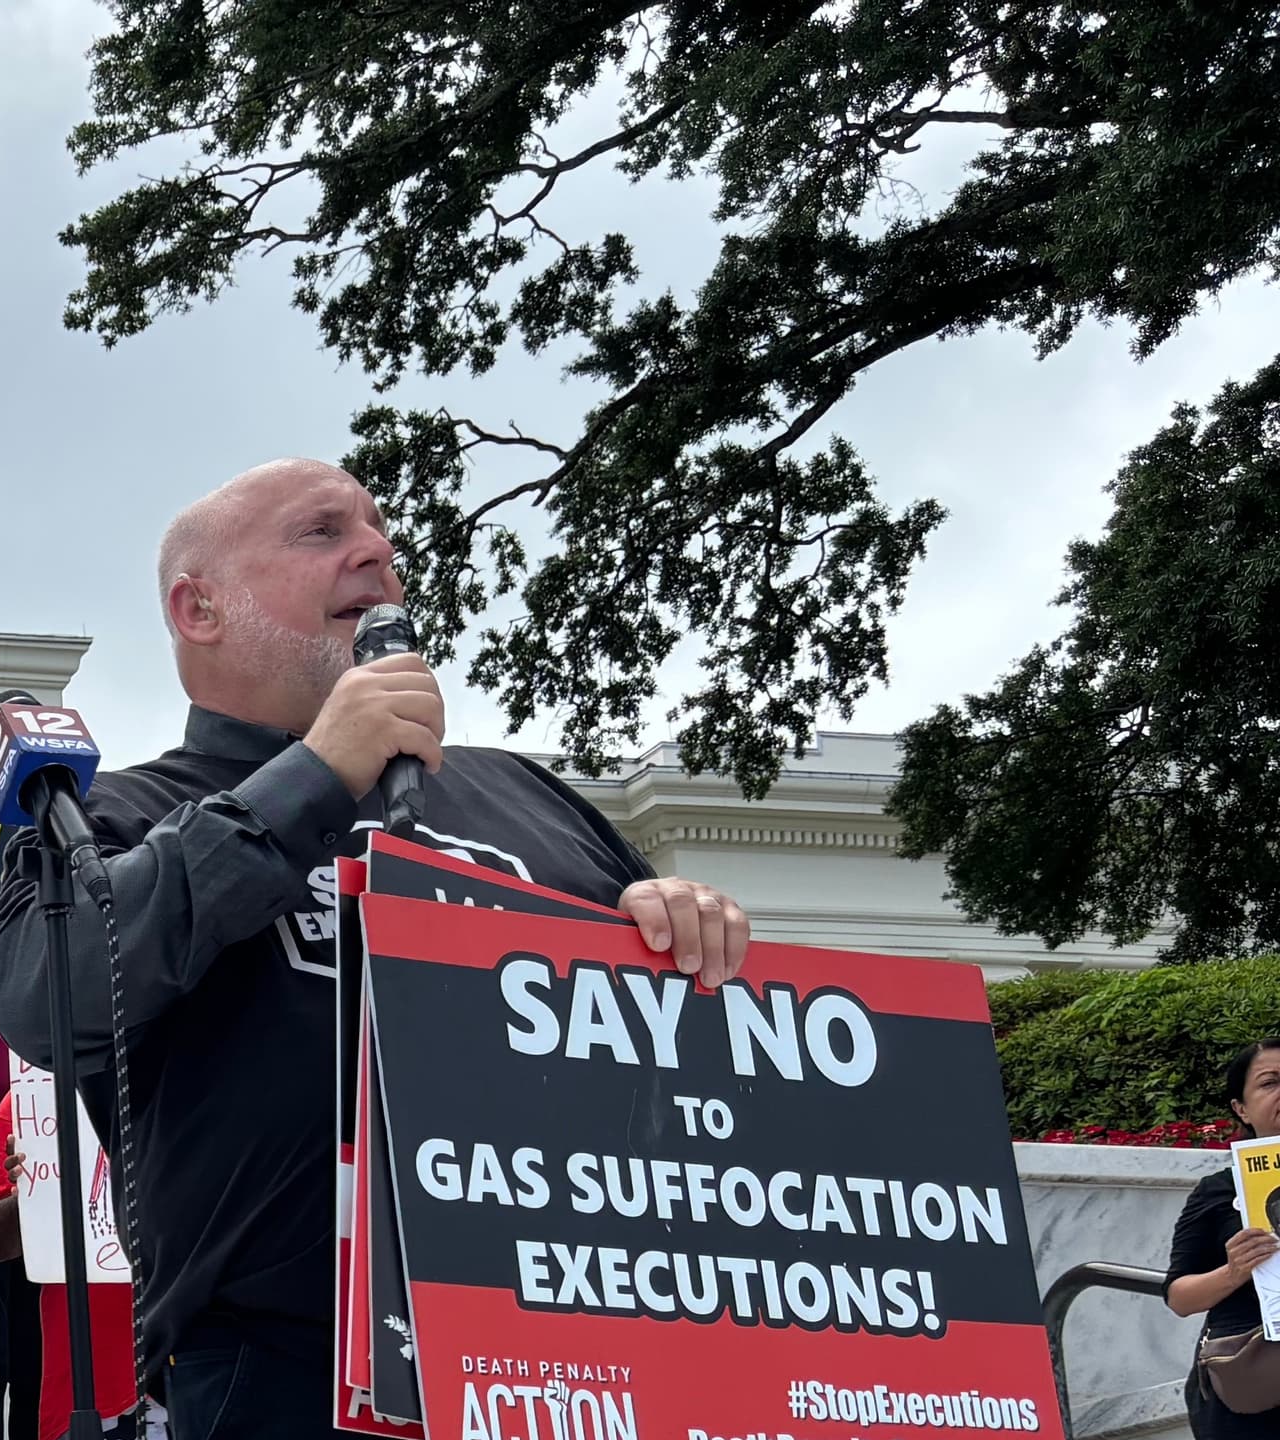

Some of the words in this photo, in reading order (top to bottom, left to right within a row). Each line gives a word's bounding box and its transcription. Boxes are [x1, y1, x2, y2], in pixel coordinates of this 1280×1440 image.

[11, 711, 83, 736] 12
[22, 737, 94, 751] WSFA
[500, 959, 689, 1069] SAY
[723, 984, 878, 1088] NO
[674, 1095, 735, 1140] TO
[1246, 1155, 1269, 1173] THE
[415, 1137, 550, 1210] GAS
[567, 1152, 1008, 1246] SUFFOCATION
[517, 1239, 940, 1330] EXECUTIONS!
[462, 1355, 530, 1379] DEATH
[539, 1361, 631, 1383] PENALTY
[788, 1380, 1038, 1432] #StopExecutions
